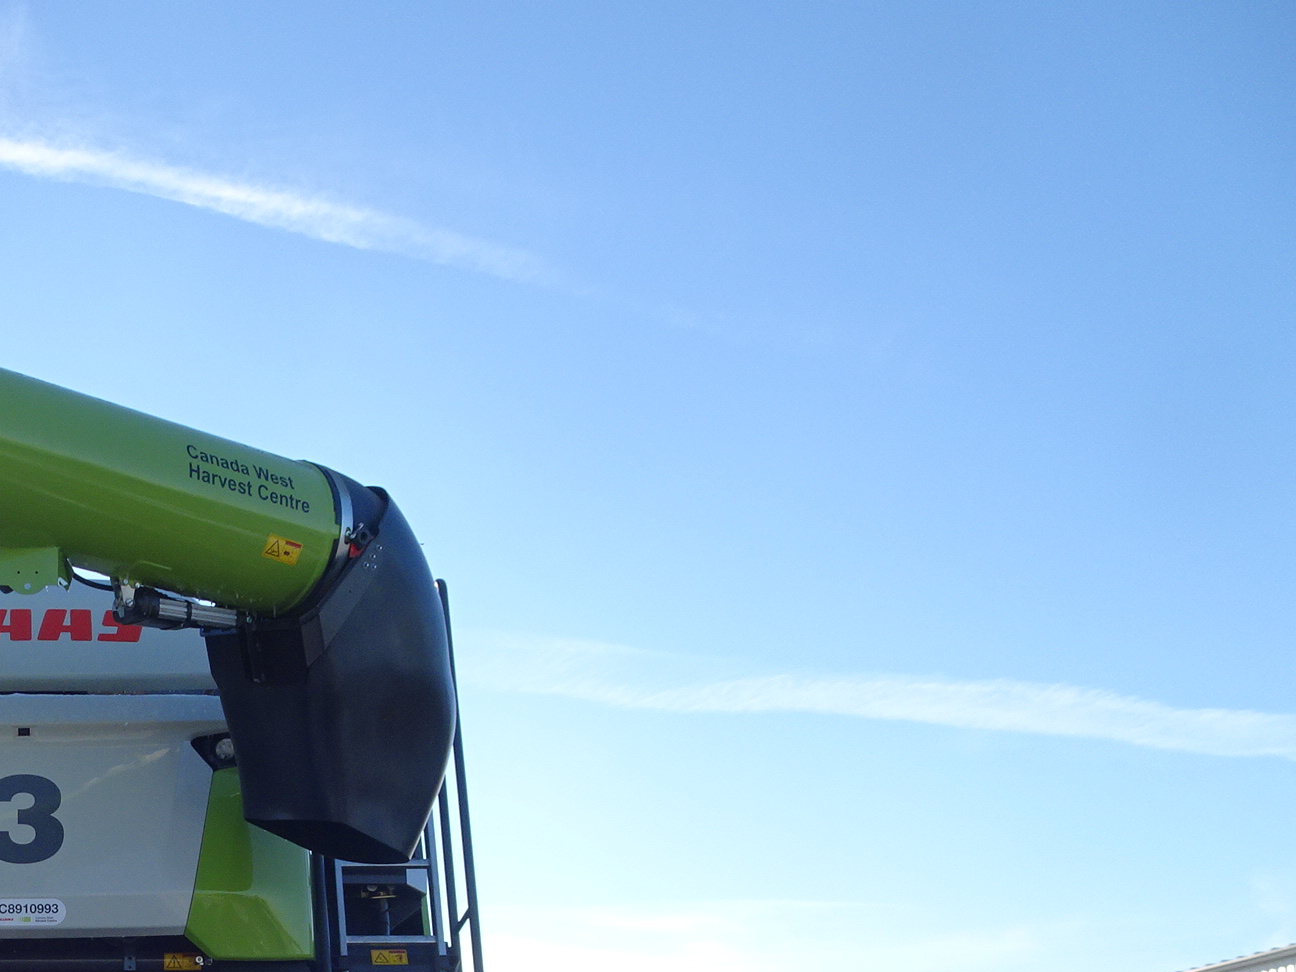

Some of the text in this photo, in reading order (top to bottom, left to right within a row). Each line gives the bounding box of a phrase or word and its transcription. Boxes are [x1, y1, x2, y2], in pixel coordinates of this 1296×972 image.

[186, 444, 295, 489] Canada West
[189, 462, 310, 513] Harvest Centre
